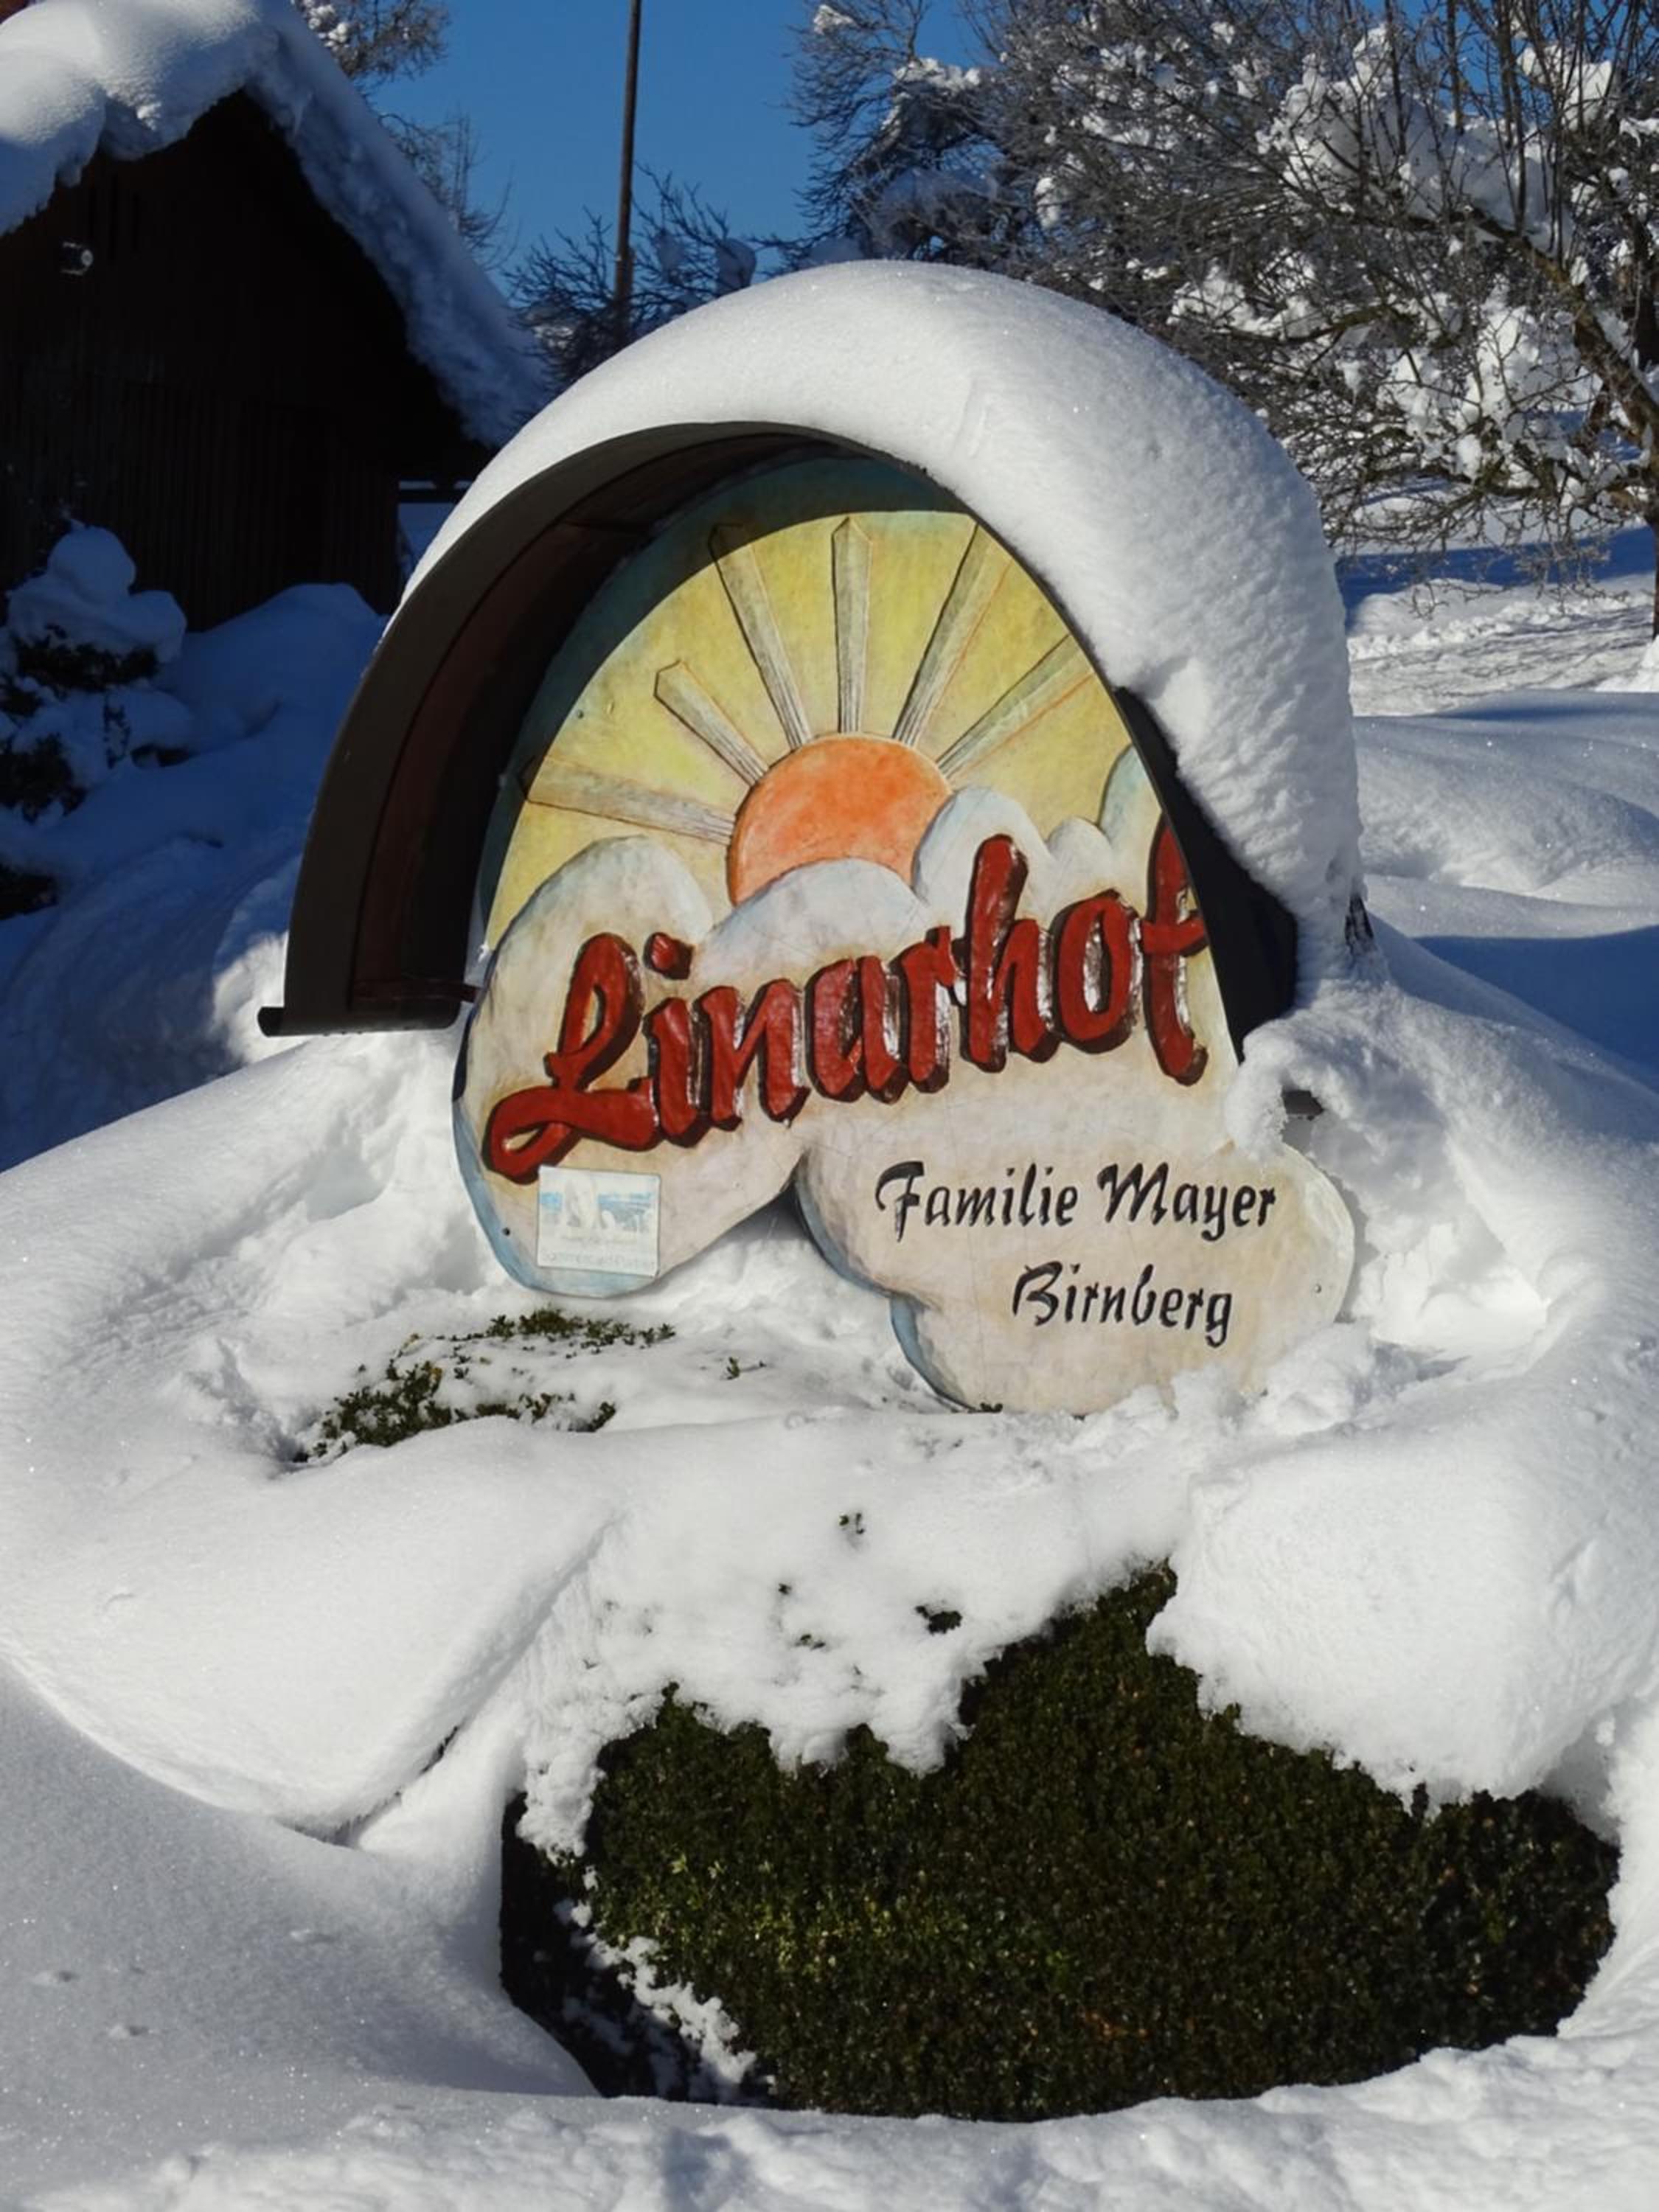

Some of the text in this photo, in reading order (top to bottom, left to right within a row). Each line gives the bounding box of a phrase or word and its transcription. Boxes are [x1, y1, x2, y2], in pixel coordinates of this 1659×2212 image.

[875, 1161, 1276, 1243] Familie Mayer
[1012, 1260, 1232, 1348] Birnberg
